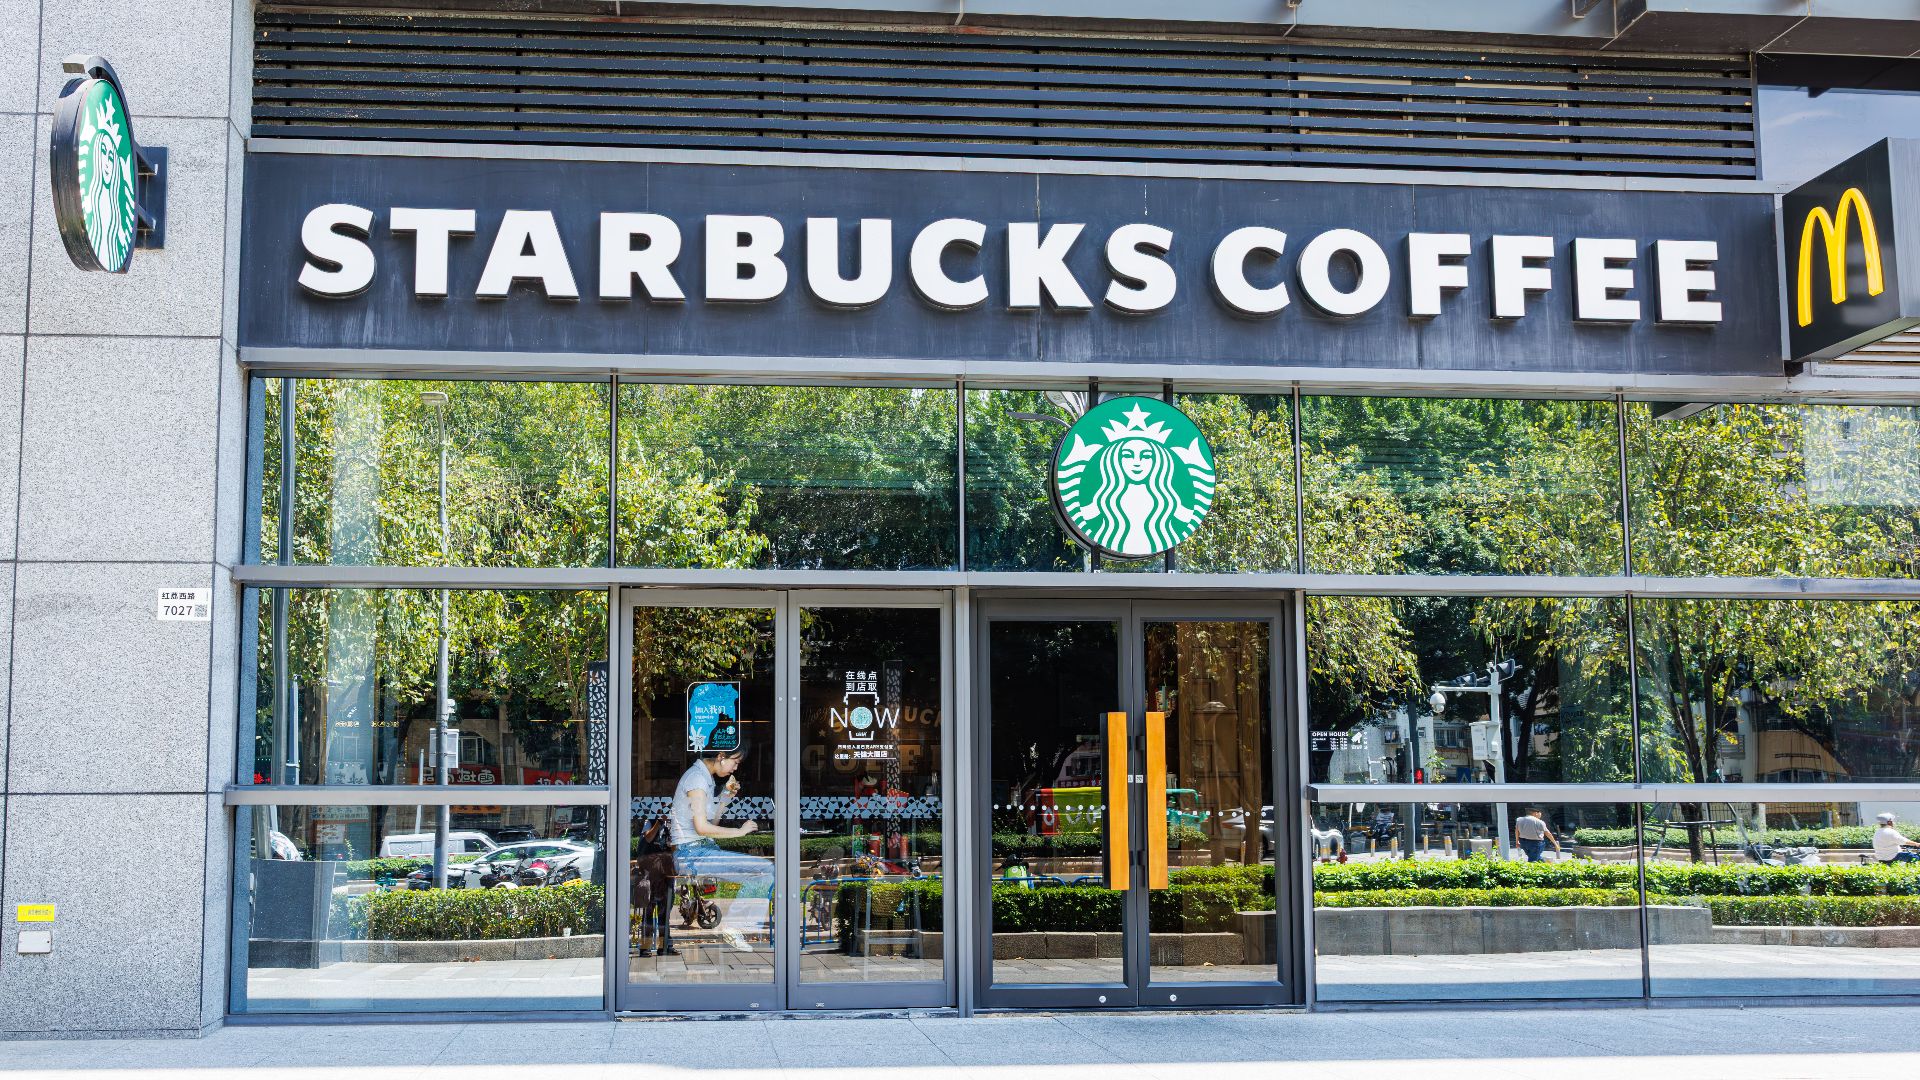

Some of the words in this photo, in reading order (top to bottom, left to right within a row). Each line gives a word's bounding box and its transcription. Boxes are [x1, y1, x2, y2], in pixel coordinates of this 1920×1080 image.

[298, 202, 1177, 312] STARBUCKS
[1209, 226, 1723, 325] COFFEE
[163, 605, 193, 616] 7027
[845, 671, 878, 681] 在线点
[845, 682, 878, 692] 到店取
